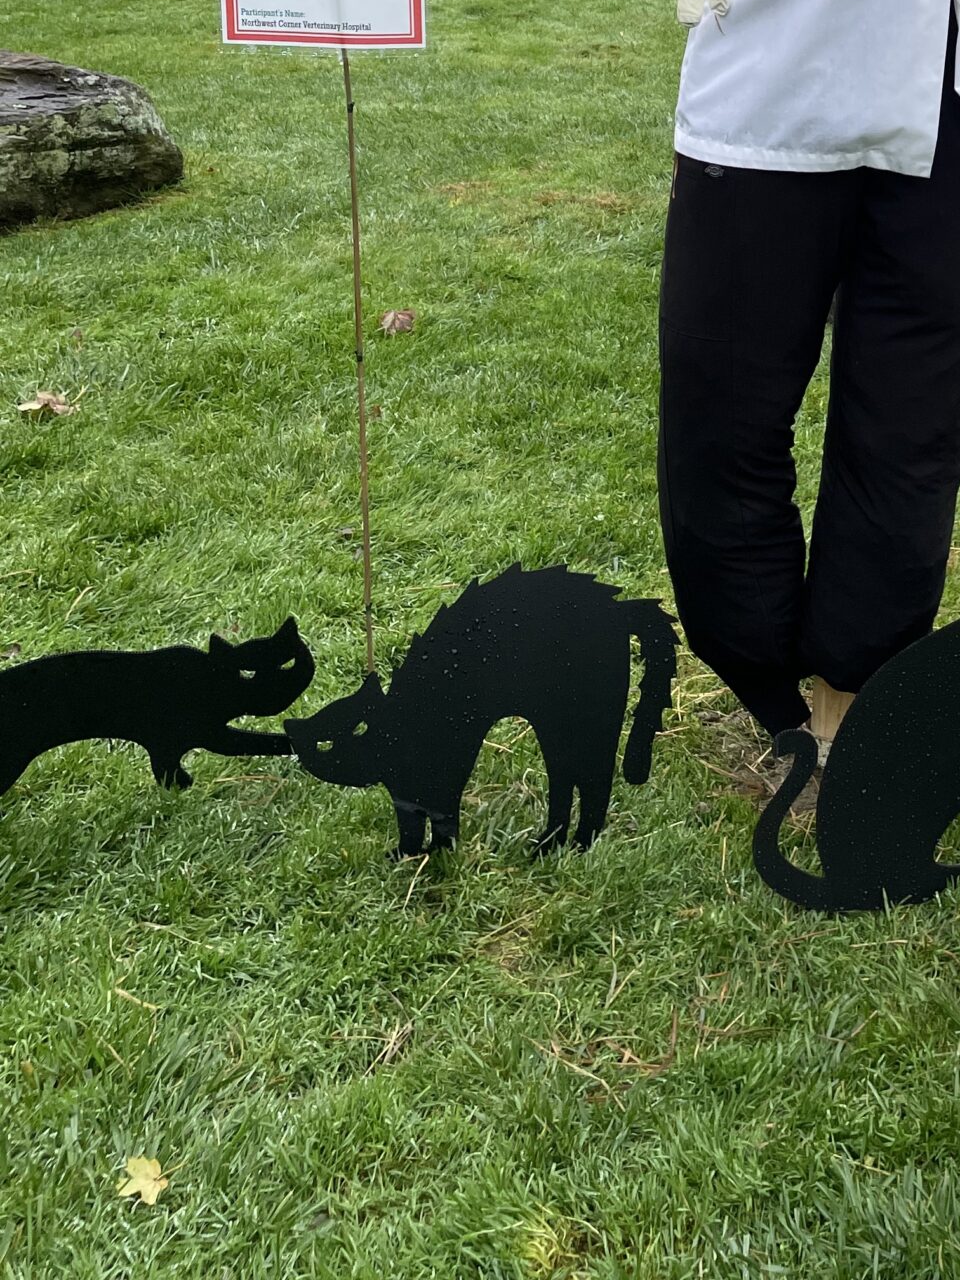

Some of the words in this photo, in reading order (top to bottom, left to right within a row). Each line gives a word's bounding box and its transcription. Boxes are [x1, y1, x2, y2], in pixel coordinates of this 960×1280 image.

[241, 8, 284, 18] Participant's
[241, 19, 277, 28] Northwest
[278, 20, 301, 28] Corner
[342, 22, 371, 32] Hospital
